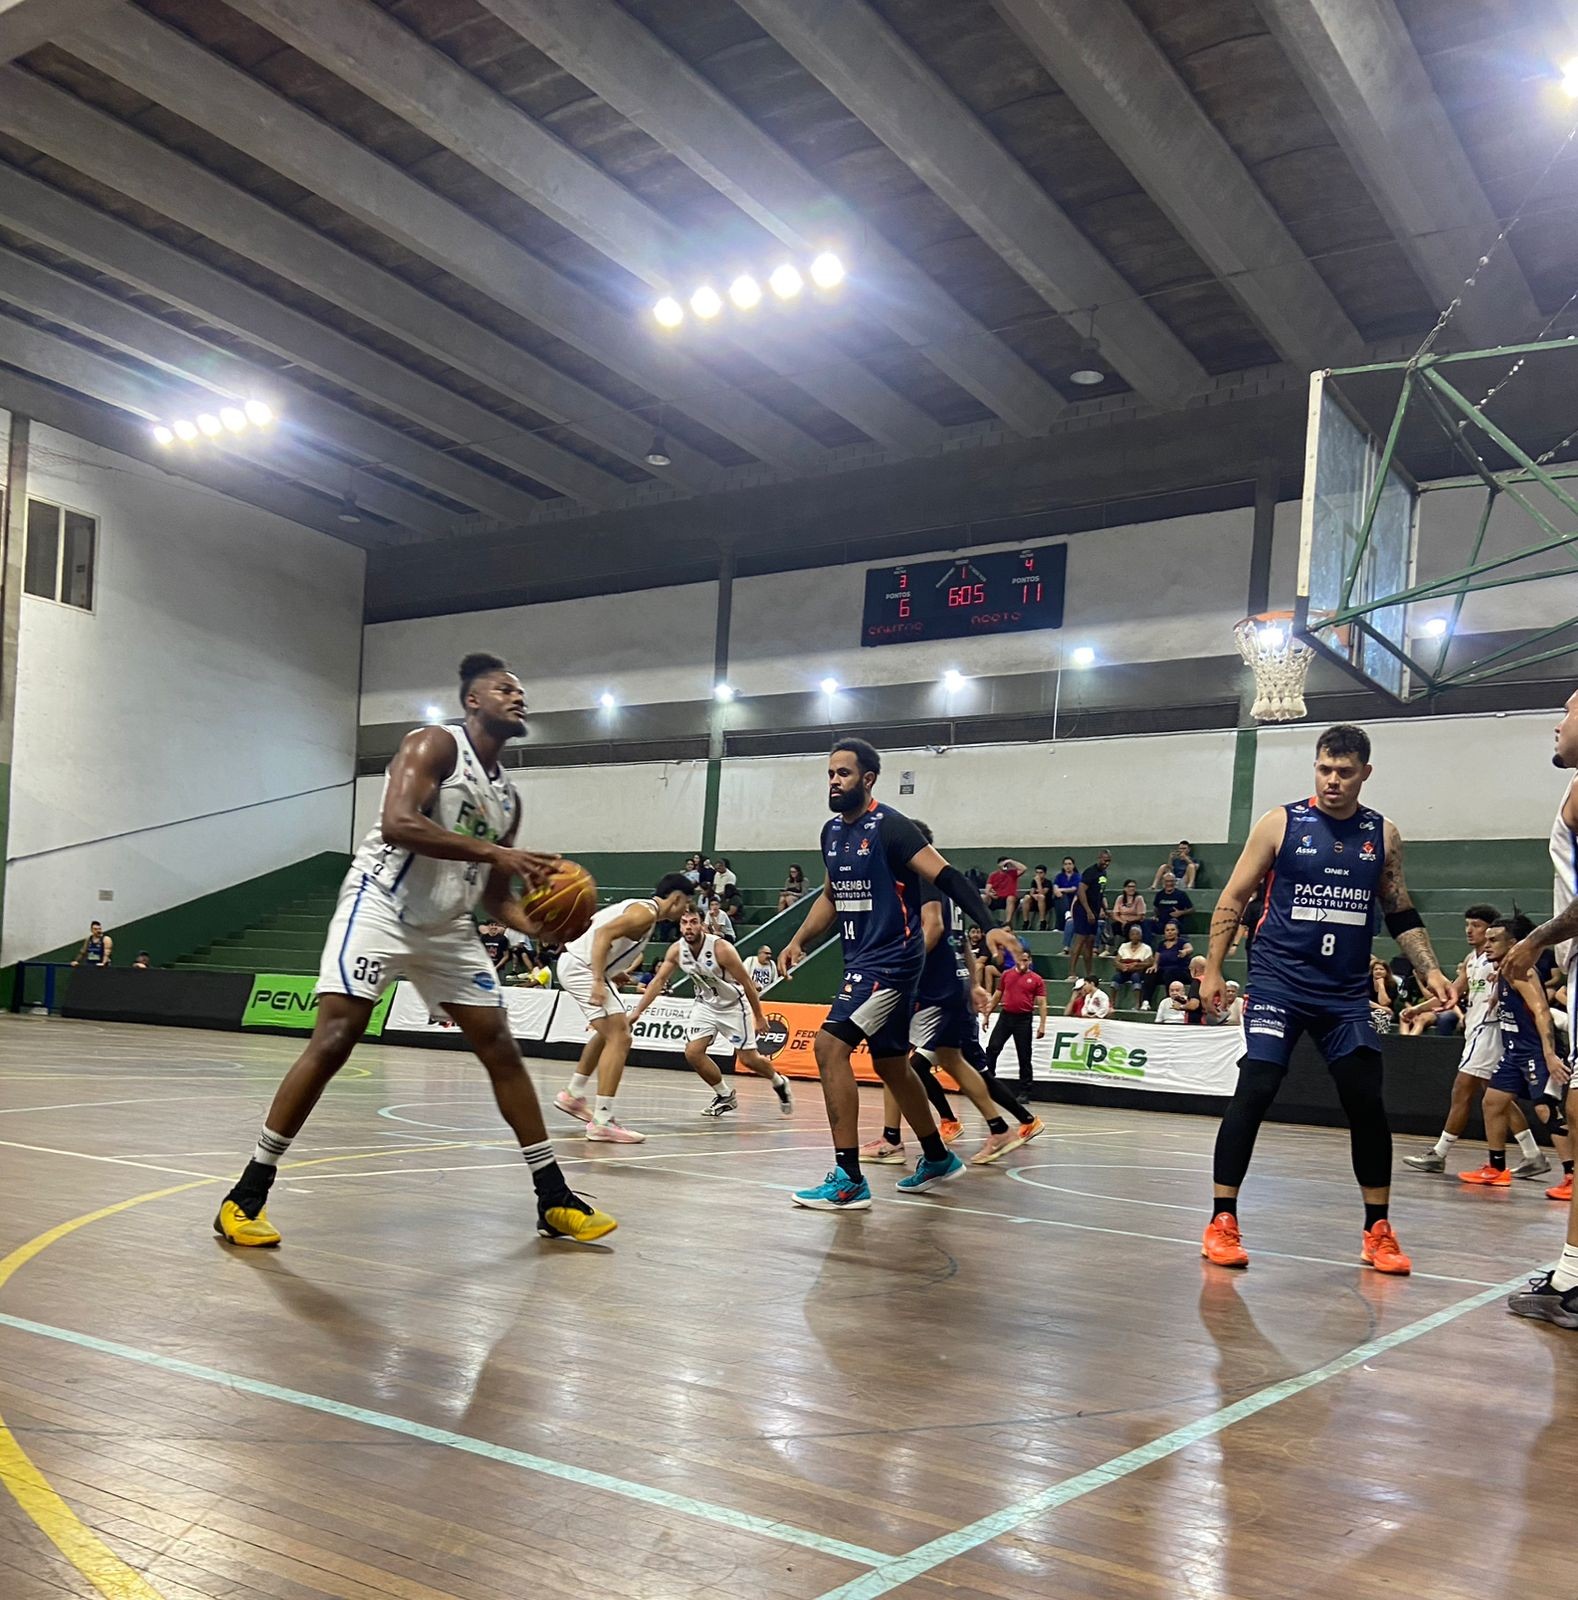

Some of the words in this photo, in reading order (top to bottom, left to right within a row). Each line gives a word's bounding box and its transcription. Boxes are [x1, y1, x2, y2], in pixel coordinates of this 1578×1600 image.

[1025, 559, 1033, 572] 4
[900, 574, 907, 588] 3
[1012, 575, 1040, 584] PONTOS
[886, 590, 910, 600] PONTOS
[949, 584, 984, 606] 6:05
[899, 599, 910, 617] 6
[1324, 867, 1350, 876] ONEX
[1294, 884, 1371, 901] PACAEMBU
[1293, 897, 1368, 910] CONSTRUTORA
[843, 920, 856, 940] 14
[1321, 933, 1336, 956] 8
[353, 956, 380, 985] 33
[629, 1020, 686, 1040] anto
[790, 1039, 810, 1050] DE
[1052, 1032, 1148, 1070] Fupes
[1528, 1059, 1536, 1072] 5
